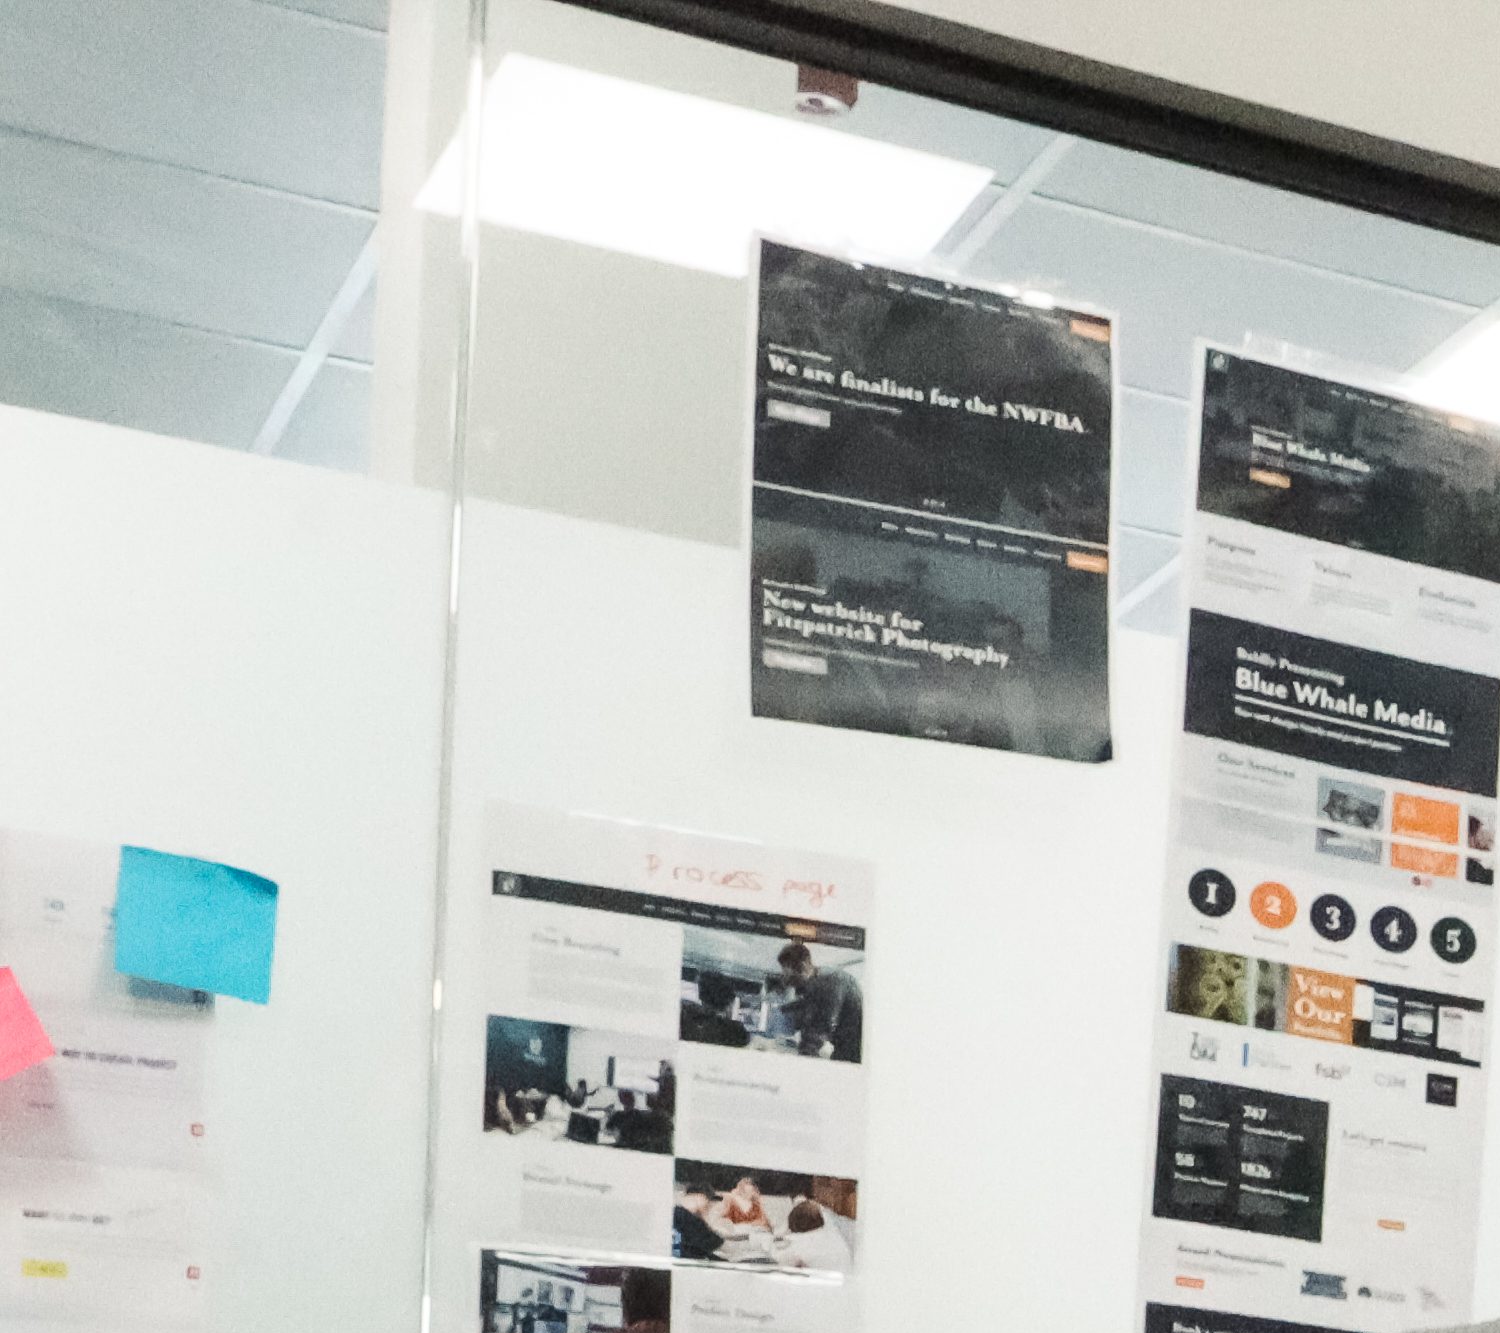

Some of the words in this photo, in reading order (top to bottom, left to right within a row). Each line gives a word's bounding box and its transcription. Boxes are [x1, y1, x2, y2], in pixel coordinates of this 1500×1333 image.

[768, 353, 797, 377] We
[803, 364, 834, 384] are
[840, 370, 925, 401] finalists
[930, 387, 961, 409] for
[964, 396, 998, 416] the
[763, 588, 806, 611] New
[811, 601, 885, 625] website
[891, 611, 925, 631] for
[763, 607, 876, 642] Fitzpatrick
[881, 628, 1010, 670] Photography
[1235, 667, 1288, 699] Blue
[1293, 681, 1368, 719] Whale
[1373, 699, 1448, 735] Media
[1206, 882, 1217, 904] 1
[1265, 895, 1281, 916] 2
[1325, 905, 1342, 931] 3
[1384, 916, 1402, 943] 4
[1445, 929, 1461, 953] 5
[1297, 974, 1345, 1000] View
[1295, 998, 1346, 1025] Our
